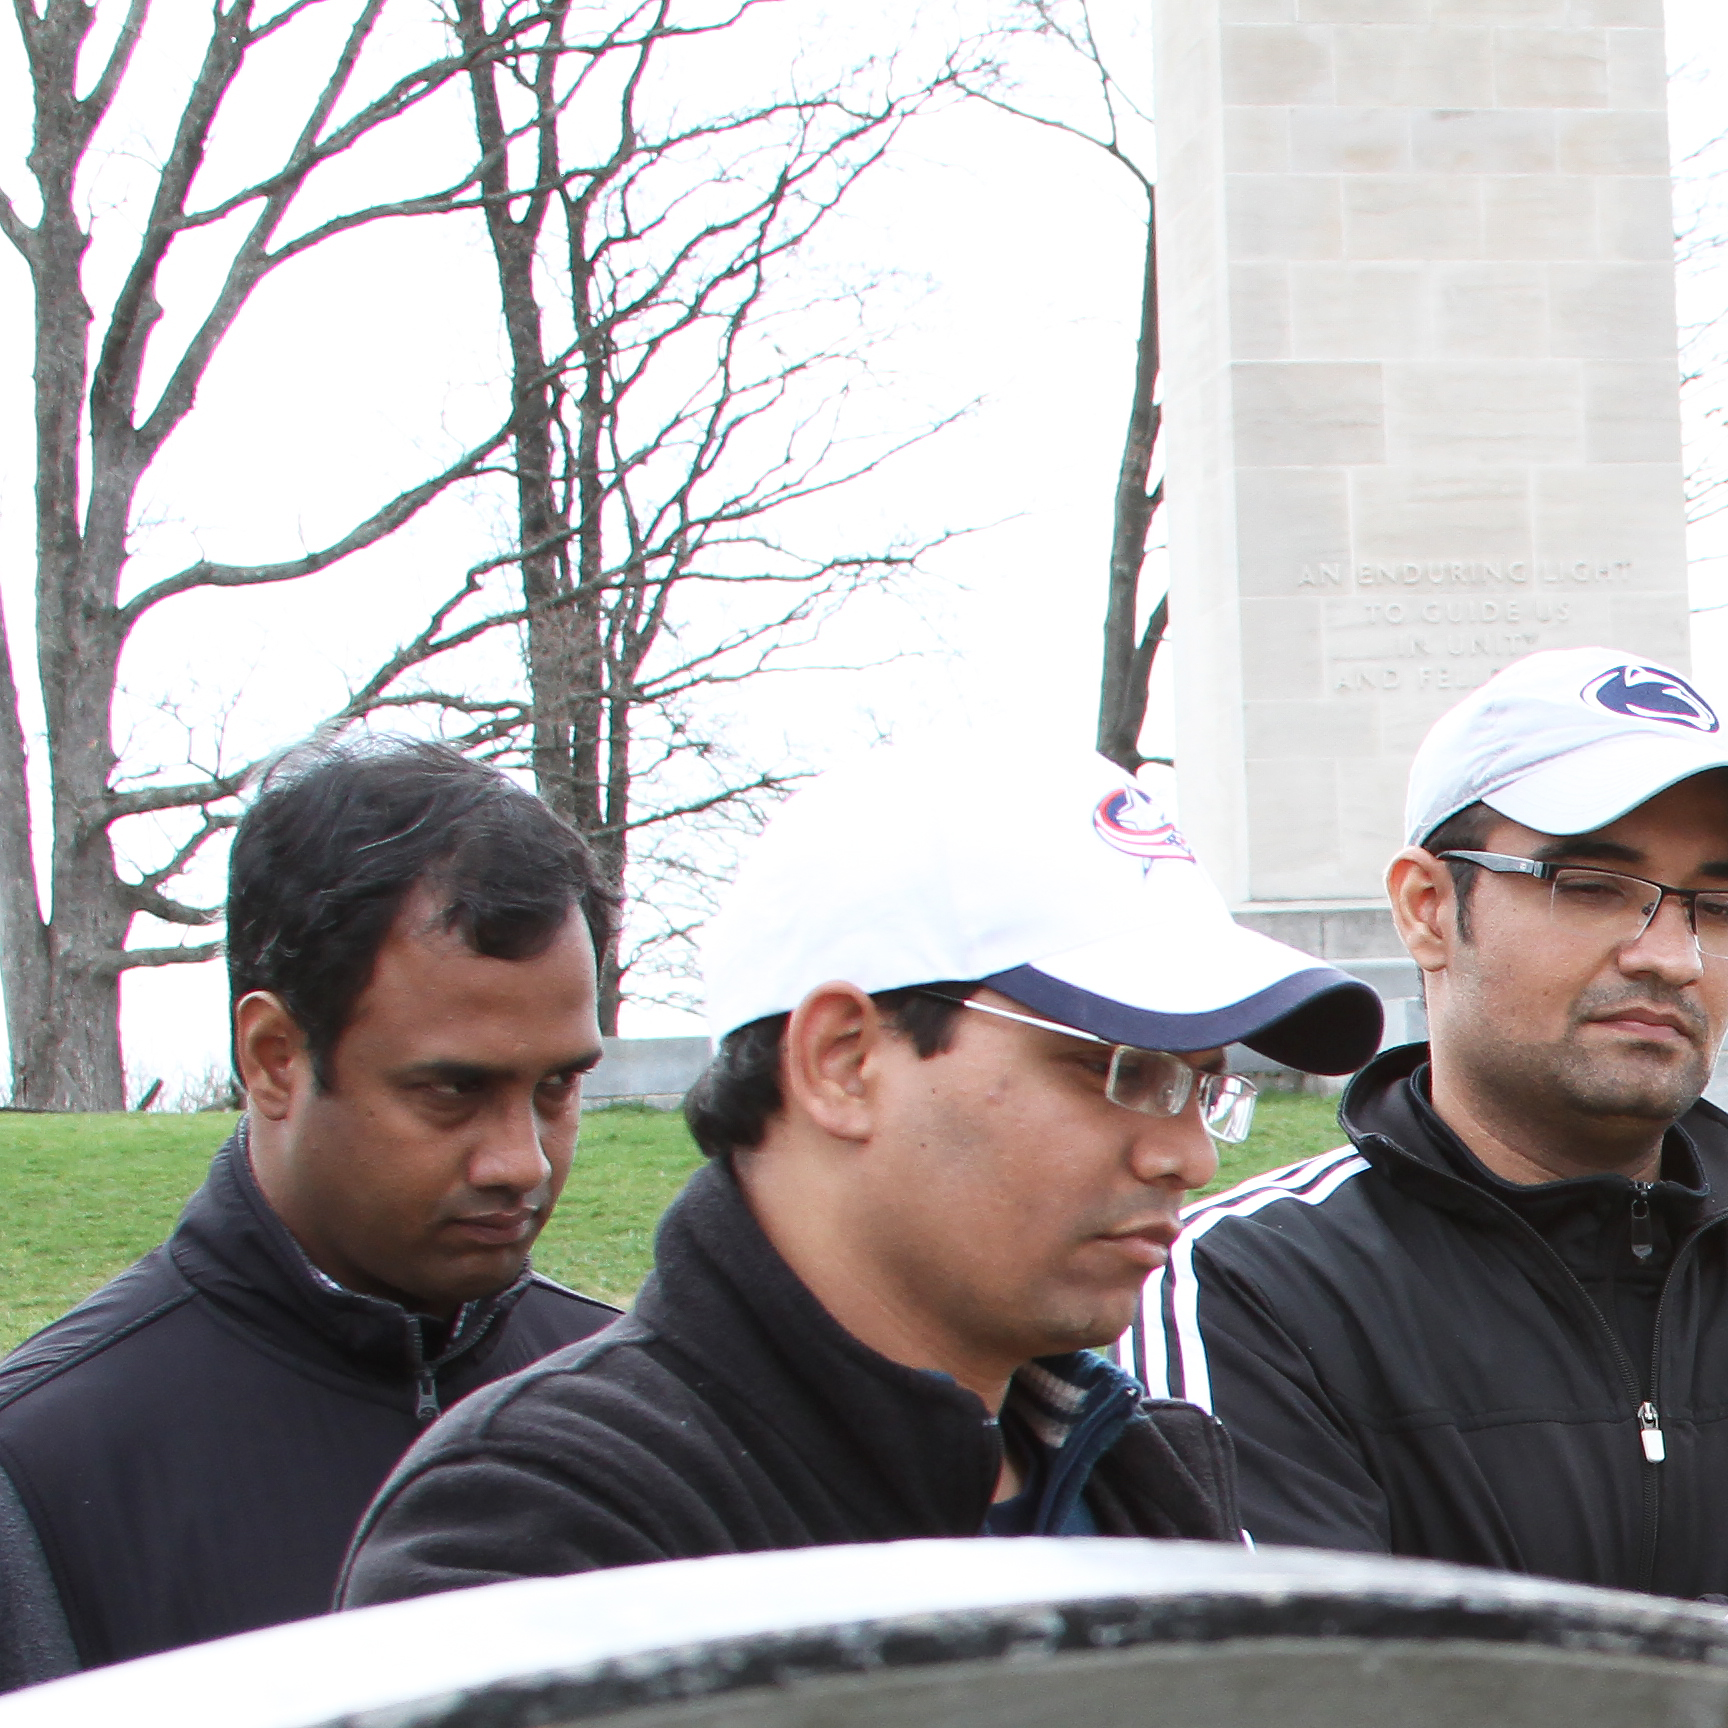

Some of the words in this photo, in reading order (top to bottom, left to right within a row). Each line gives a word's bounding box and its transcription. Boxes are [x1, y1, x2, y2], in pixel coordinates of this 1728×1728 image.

[1298, 562, 1342, 587] AN
[1357, 561, 1528, 587] ENDURING
[1543, 560, 1633, 585] LIGHT
[1365, 603, 1405, 625] TO
[1422, 602, 1520, 624] GUIDE
[1535, 601, 1571, 623] US
[1398, 636, 1430, 657] IN
[1447, 634, 1540, 656] UNITY
[1335, 669, 1400, 692] AND
